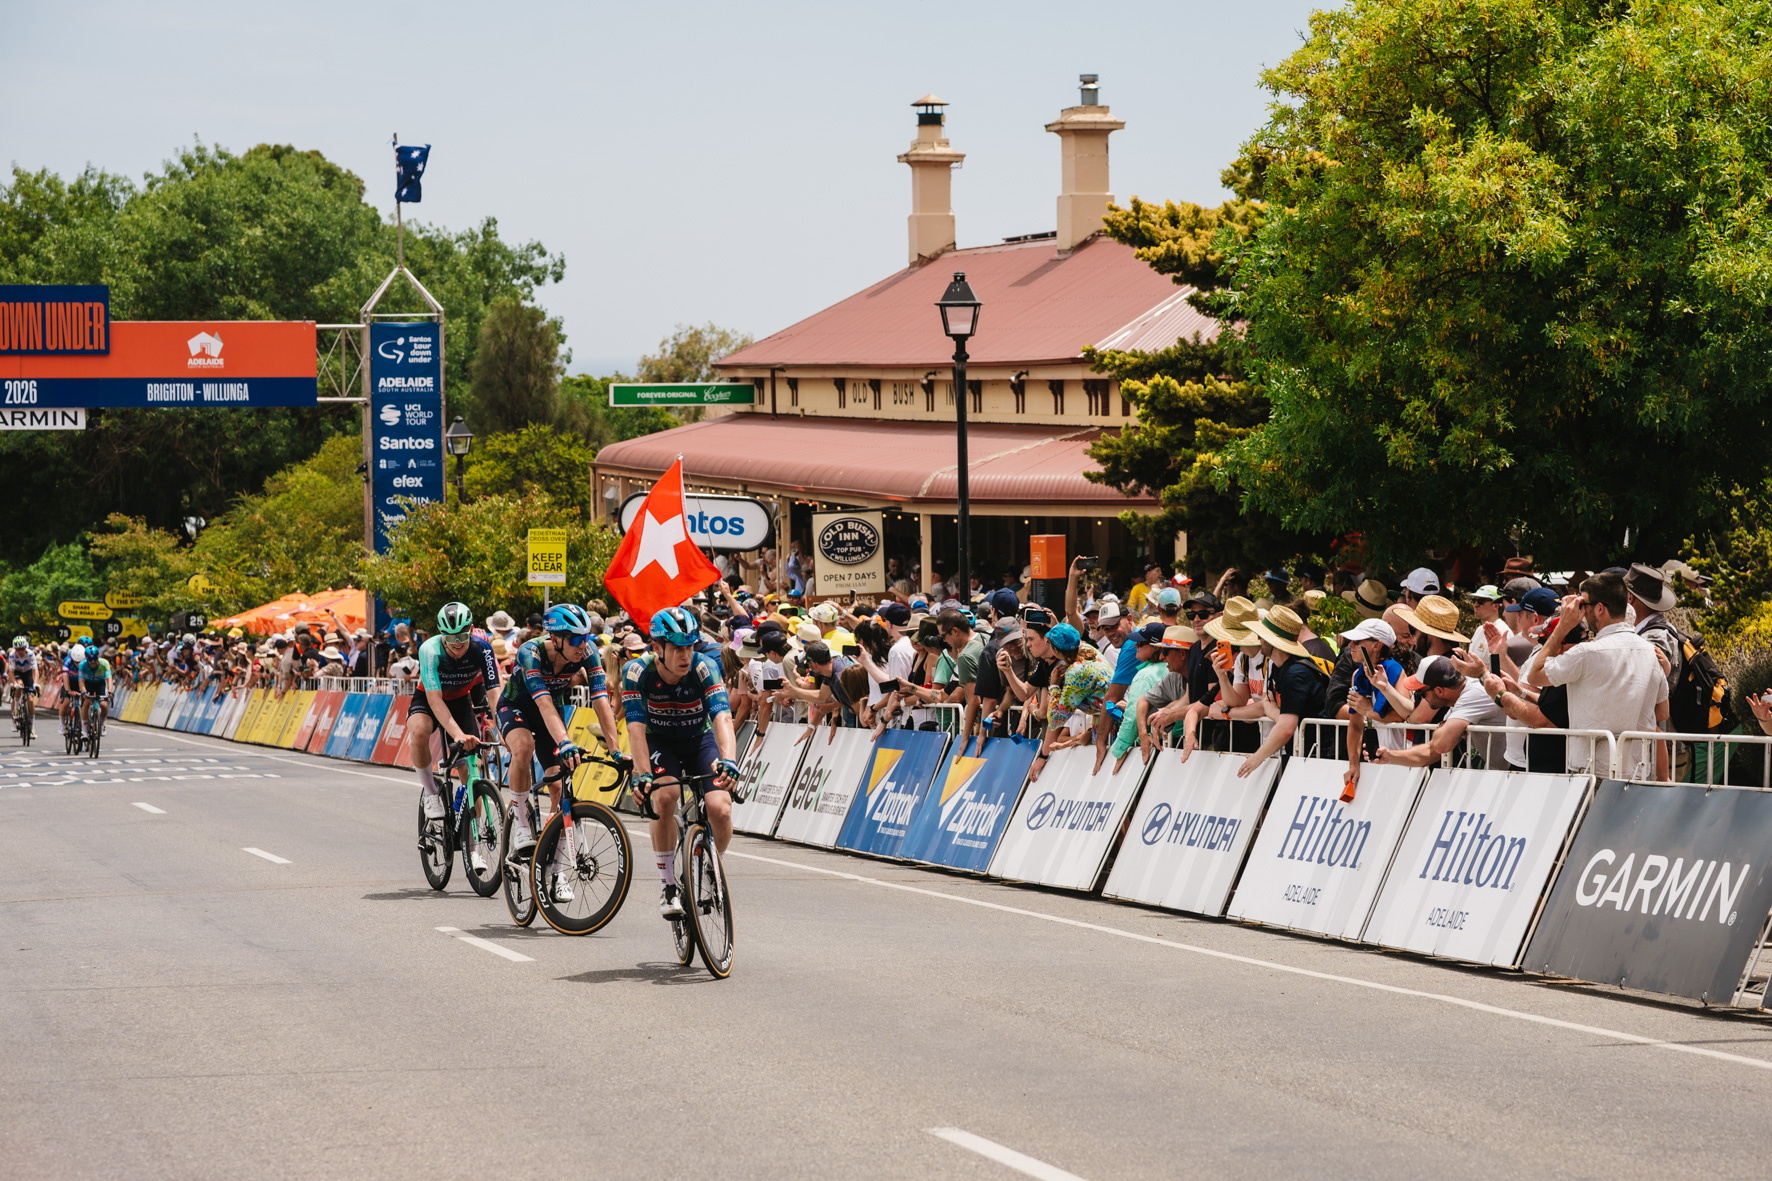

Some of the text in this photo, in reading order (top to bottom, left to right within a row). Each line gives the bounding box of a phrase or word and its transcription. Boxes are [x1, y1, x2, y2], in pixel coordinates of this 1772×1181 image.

[0, 302, 105, 350] OWN UNDER
[378, 377, 434, 387] ADELAIDE
[5, 380, 38, 404] 2026
[147, 383, 194, 402] BRIGHTON
[203, 383, 249, 402] WILLUNGA
[637, 391, 666, 399] FOREVER
[666, 391, 697, 399] ORIGINAL
[852, 382, 868, 404] OLD
[893, 383, 914, 405] BUSH
[380, 436, 435, 450] Santos
[392, 474, 423, 488] efex
[688, 511, 745, 536] ntos
[823, 521, 875, 541] OLD BUSH
[838, 531, 859, 541] INN
[532, 552, 562, 562] KEEP
[532, 562, 562, 571] CLEAR
[834, 552, 866, 562] WILLUNGA
[823, 572, 877, 582] OPEN 7 DAYS
[842, 595, 875, 604] CLSSICS
[107, 623, 119, 633] 50
[190, 615, 203, 627] 25
[59, 629, 68, 637] 75
[482, 648, 496, 680] Adecco
[648, 706, 703, 716] SOUDAL
[792, 755, 832, 813] efex
[872, 781, 919, 833] Ziptrak
[1050, 798, 1116, 832] HYUNDAI
[946, 790, 1004, 845] Ziptrak
[1167, 811, 1242, 852] HYUNDAI
[1277, 795, 1372, 869] Hilton
[1419, 810, 1527, 890] Hilton
[1282, 884, 1321, 906] ADELAIDE
[1425, 907, 1469, 931] ADELAIDE
